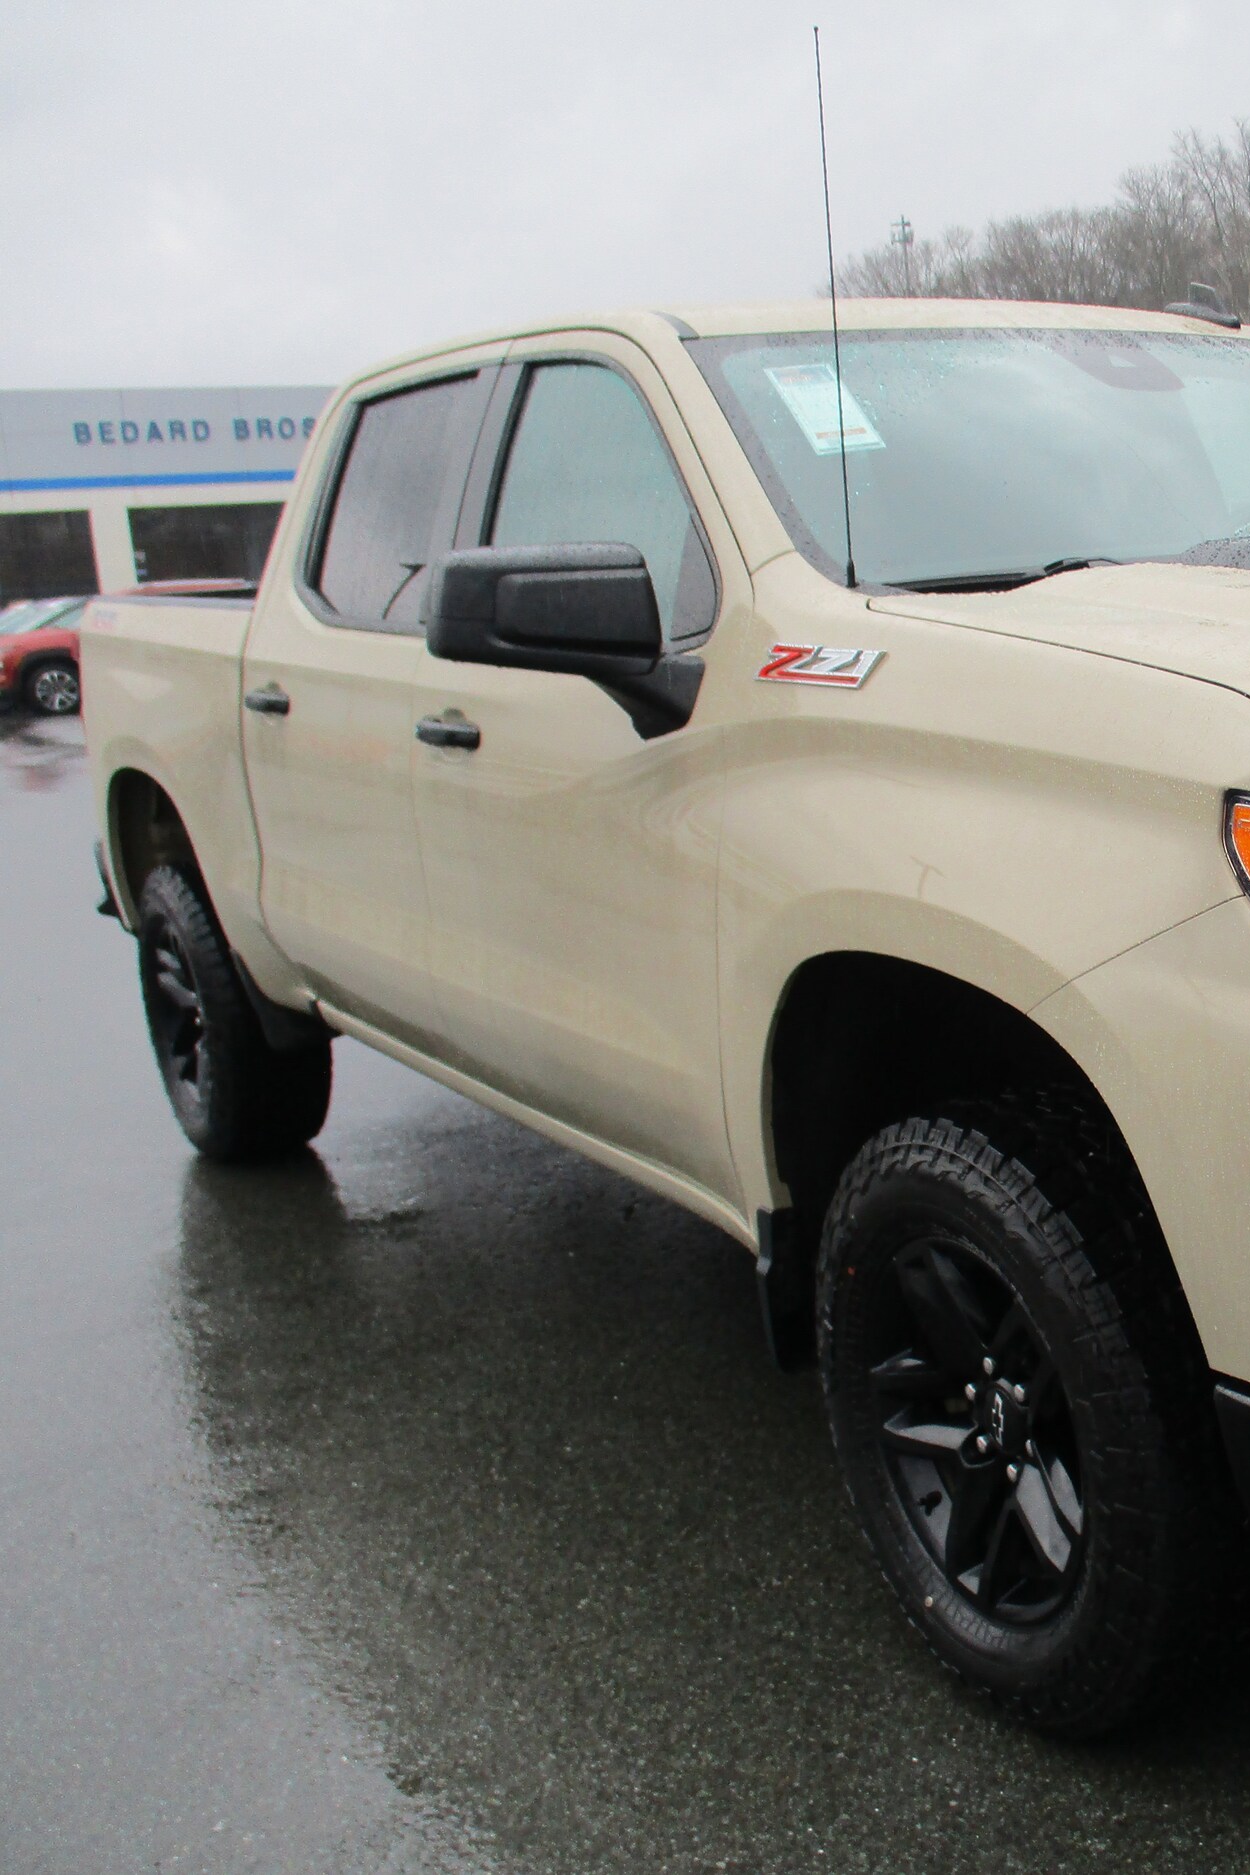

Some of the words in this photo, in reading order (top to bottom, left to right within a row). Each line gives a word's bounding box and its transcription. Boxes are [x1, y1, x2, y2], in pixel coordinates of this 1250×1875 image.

[73, 418, 210, 445] BEDARD
[233, 416, 316, 441] BROS
[754, 643, 887, 690] Z71
